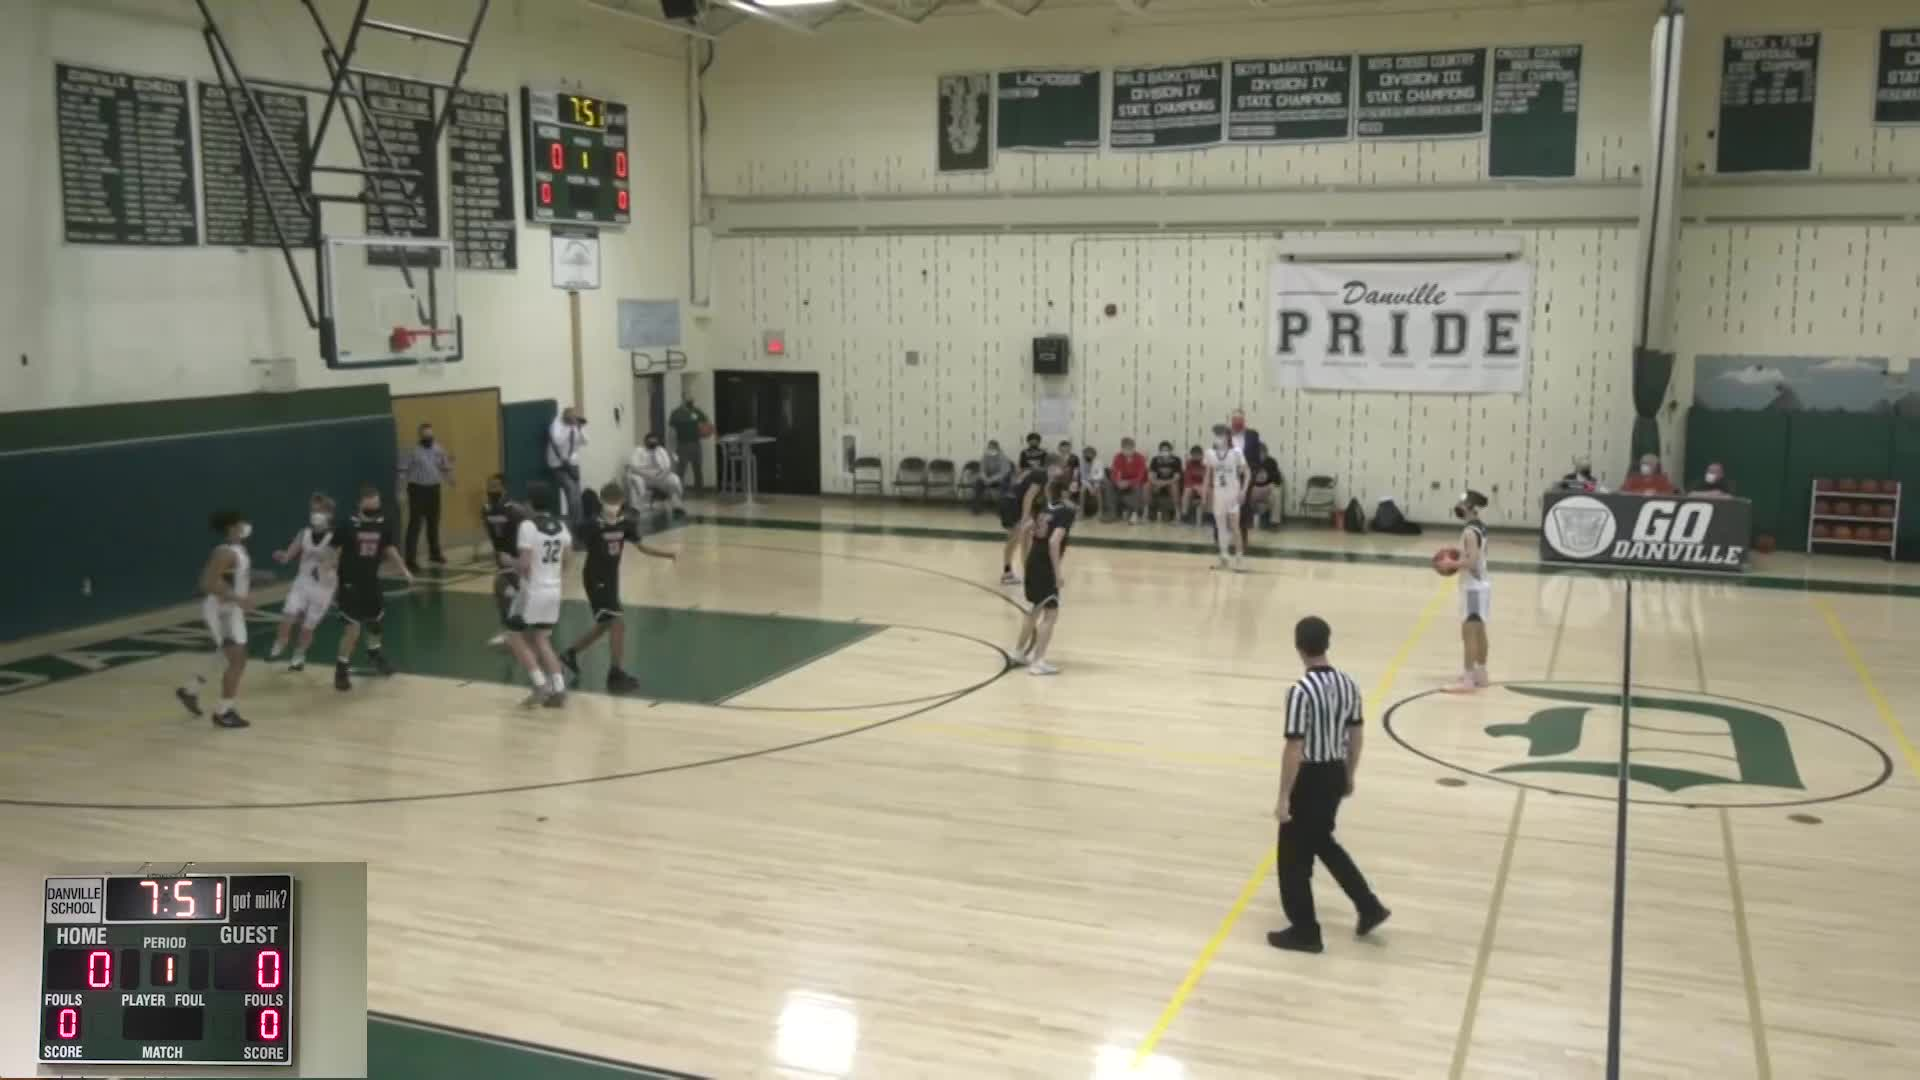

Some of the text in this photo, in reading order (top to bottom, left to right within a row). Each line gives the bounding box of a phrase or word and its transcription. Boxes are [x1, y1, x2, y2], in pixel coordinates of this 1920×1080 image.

[1148, 65, 1217, 84] BASKETBALL
[1268, 59, 1346, 75] BASKETBALL
[1250, 76, 1328, 91] DIVISION IV
[1379, 70, 1462, 87] DIVISION III
[1131, 84, 1201, 100] DIVISION IV
[1237, 92, 1343, 108] STATE CHAMPIONS
[1366, 87, 1475, 104] STATE CHAMPIONS
[1118, 103, 1152, 117] STATE
[1154, 99, 1216, 115] CHAMPIONS
[552, 143, 627, 178] 0 1 0
[541, 183, 628, 210] 0 0
[1343, 280, 1449, 306] Danville
[1277, 309, 1521, 357] PRIDE
[1632, 500, 1714, 544] GO
[542, 539, 561, 564] 32
[1611, 540, 1743, 565] DANVILLE
